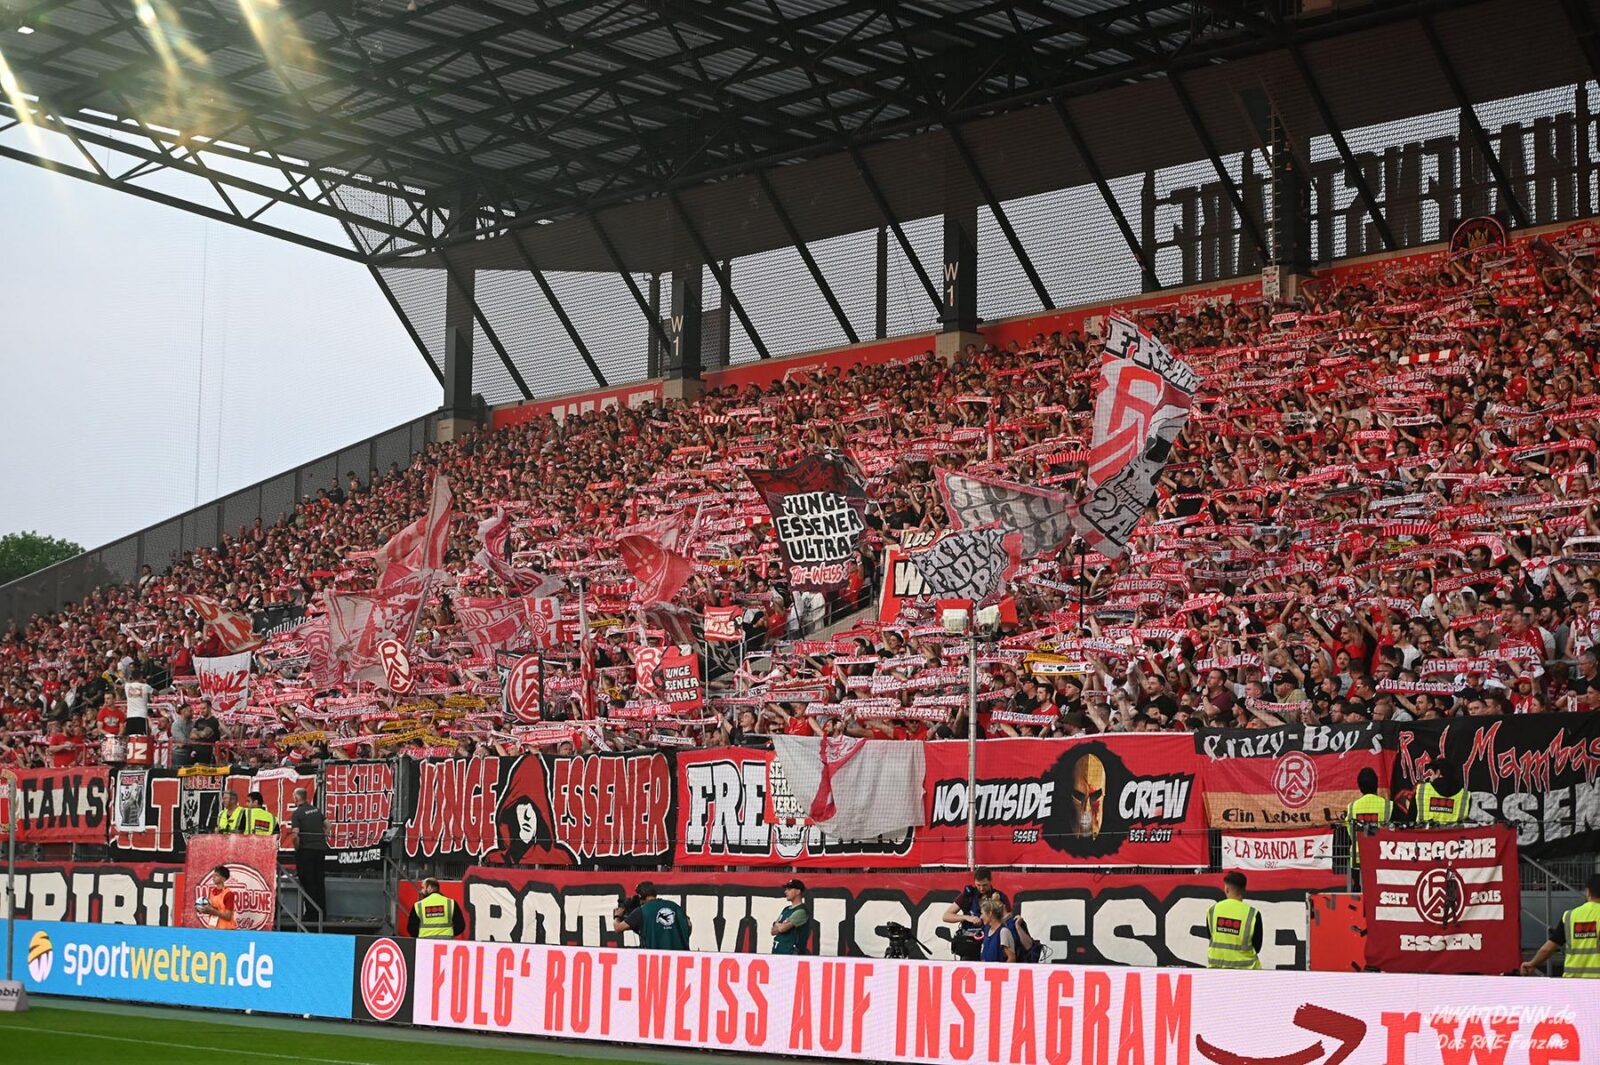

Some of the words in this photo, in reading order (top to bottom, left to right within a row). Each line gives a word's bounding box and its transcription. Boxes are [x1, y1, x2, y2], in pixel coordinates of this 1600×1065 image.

[944, 262, 959, 281] W
[670, 314, 685, 333] W
[782, 491, 847, 516] JUNGE
[776, 509, 864, 541] ESSENER
[325, 763, 394, 793] SEKTION
[22, 774, 106, 830] FANS
[325, 793, 393, 821] STADION
[404, 757, 500, 857] JUNGE
[552, 753, 672, 858] ESSENER
[686, 760, 776, 857] FRE
[932, 781, 1055, 823] NORTHSIDE
[1118, 778, 1191, 820] CREW
[1222, 808, 1255, 823] Ein
[1261, 808, 1312, 824] Leben
[1323, 807, 1349, 822] La
[1150, 829, 1173, 842] 2011
[1234, 839, 1251, 859] LA
[1254, 839, 1299, 860] BANDA
[1379, 838, 1497, 862] KATEGORIE
[1379, 892, 1409, 905] SEIT
[1469, 889, 1501, 904] 2015
[1399, 933, 1483, 951] ESSEN
[63, 941, 274, 989] sportwetten.de
[543, 948, 770, 1047] ROT-WEISS
[788, 960, 876, 1054] AUF
[895, 964, 1193, 1065] INSTAGRAM
